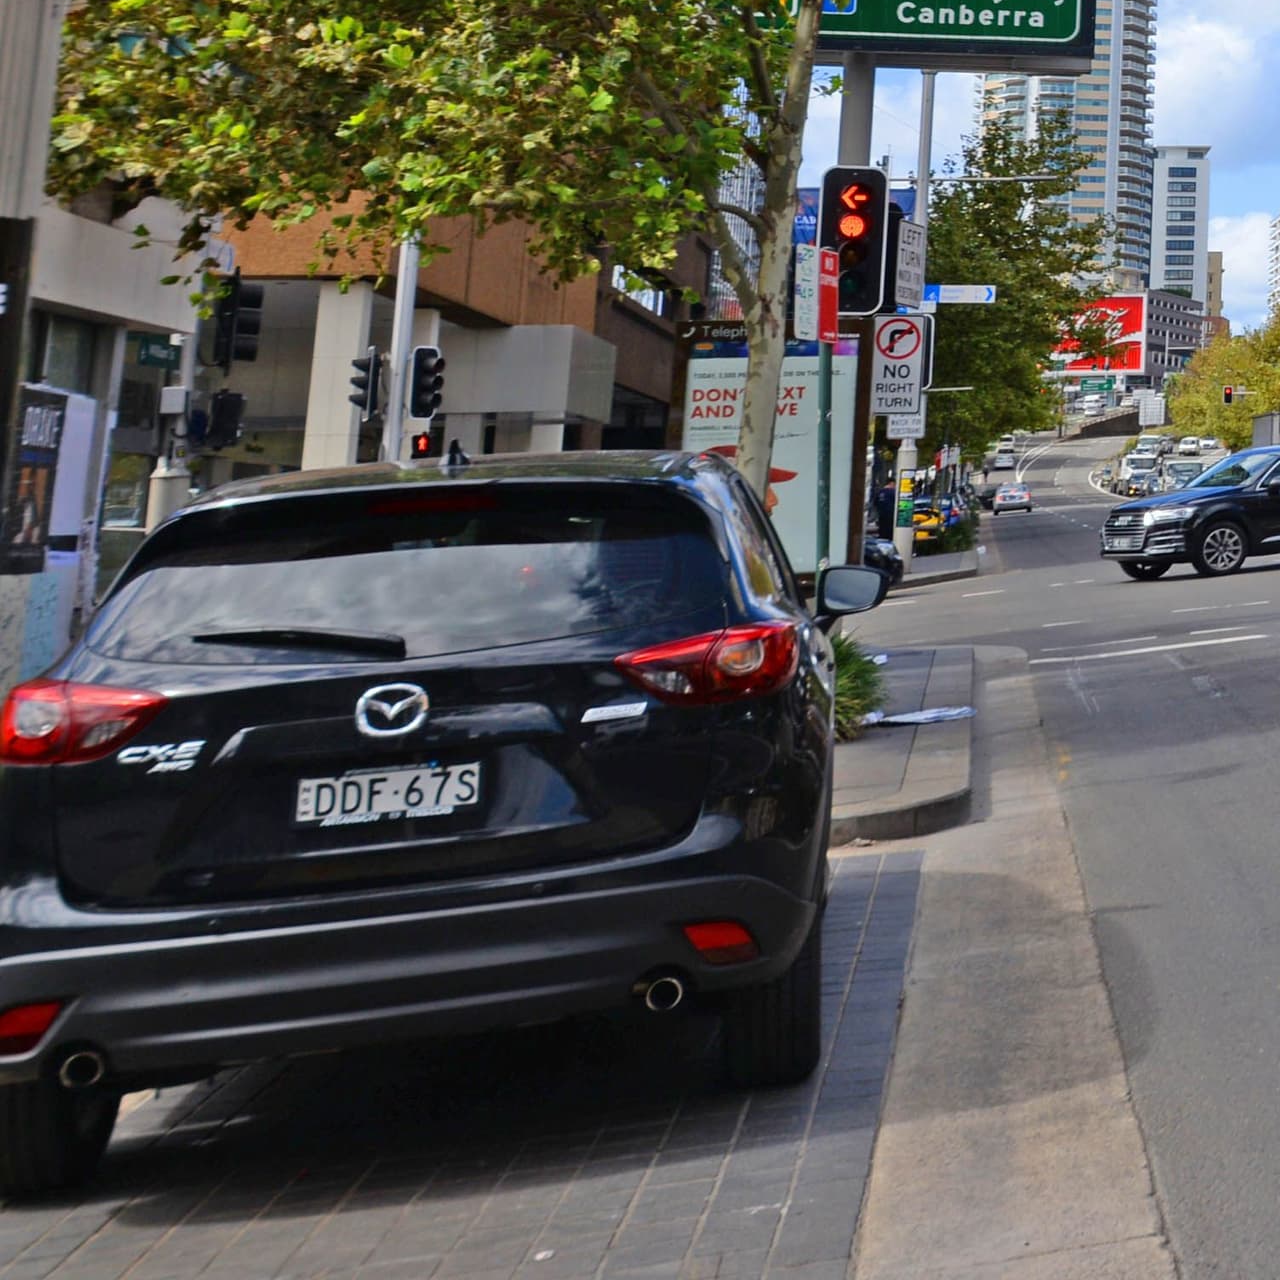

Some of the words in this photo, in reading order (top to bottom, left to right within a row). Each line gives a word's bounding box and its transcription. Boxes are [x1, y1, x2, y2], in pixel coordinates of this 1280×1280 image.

[896, 1, 1046, 28] Canberra
[902, 228, 922, 248] LEFT
[901, 247, 921, 267] TURN
[702, 325, 748, 339] Teleph
[883, 364, 911, 379] NO
[691, 388, 745, 402] DON'
[875, 382, 915, 393] RIGHT
[877, 397, 913, 408] TURN
[690, 404, 735, 419] AND
[116, 739, 208, 764] CX-5
